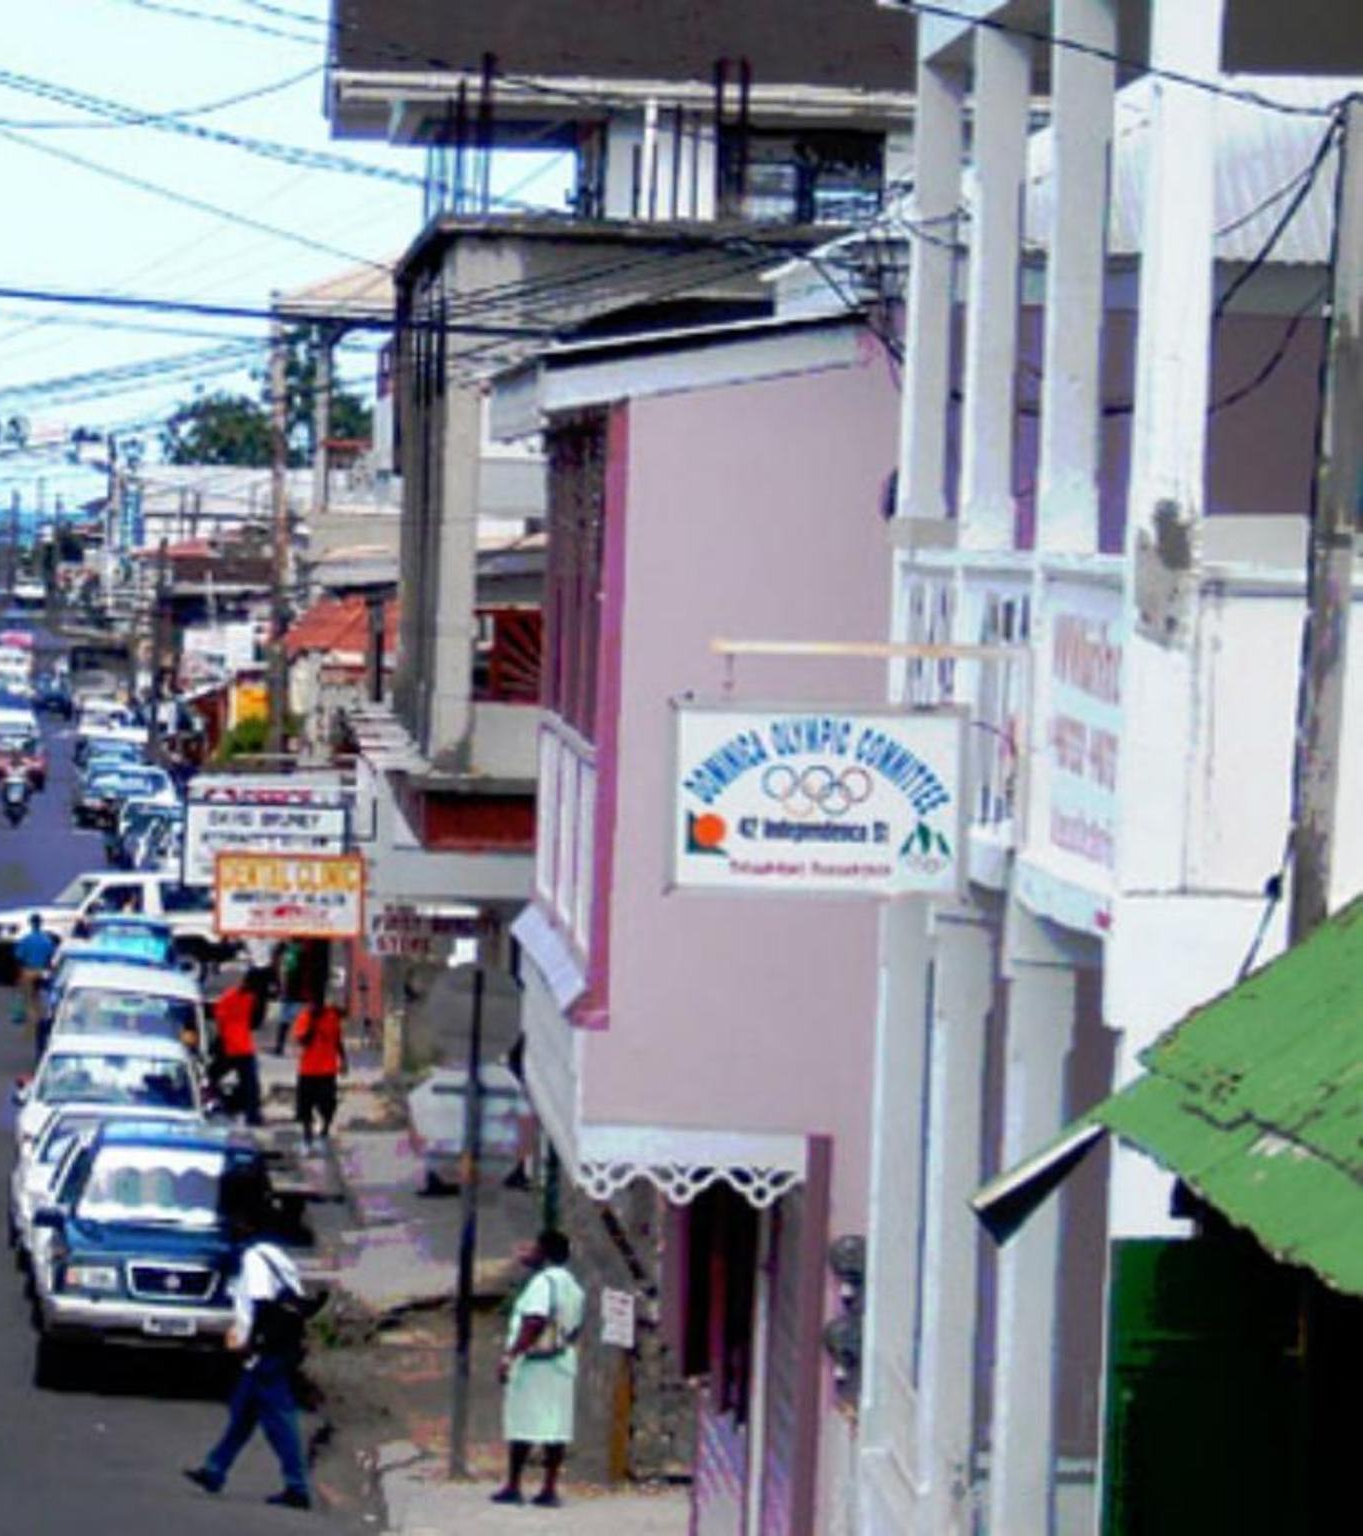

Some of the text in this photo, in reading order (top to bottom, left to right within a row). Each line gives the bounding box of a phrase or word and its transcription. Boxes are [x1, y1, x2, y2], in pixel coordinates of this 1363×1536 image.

[684, 718, 951, 814] DOMINICA OLYMPIC COMMITTEE
[739, 817, 757, 838] 42
[764, 820, 867, 843] Independence
[221, 858, 358, 893] DENTAL CLINIC
